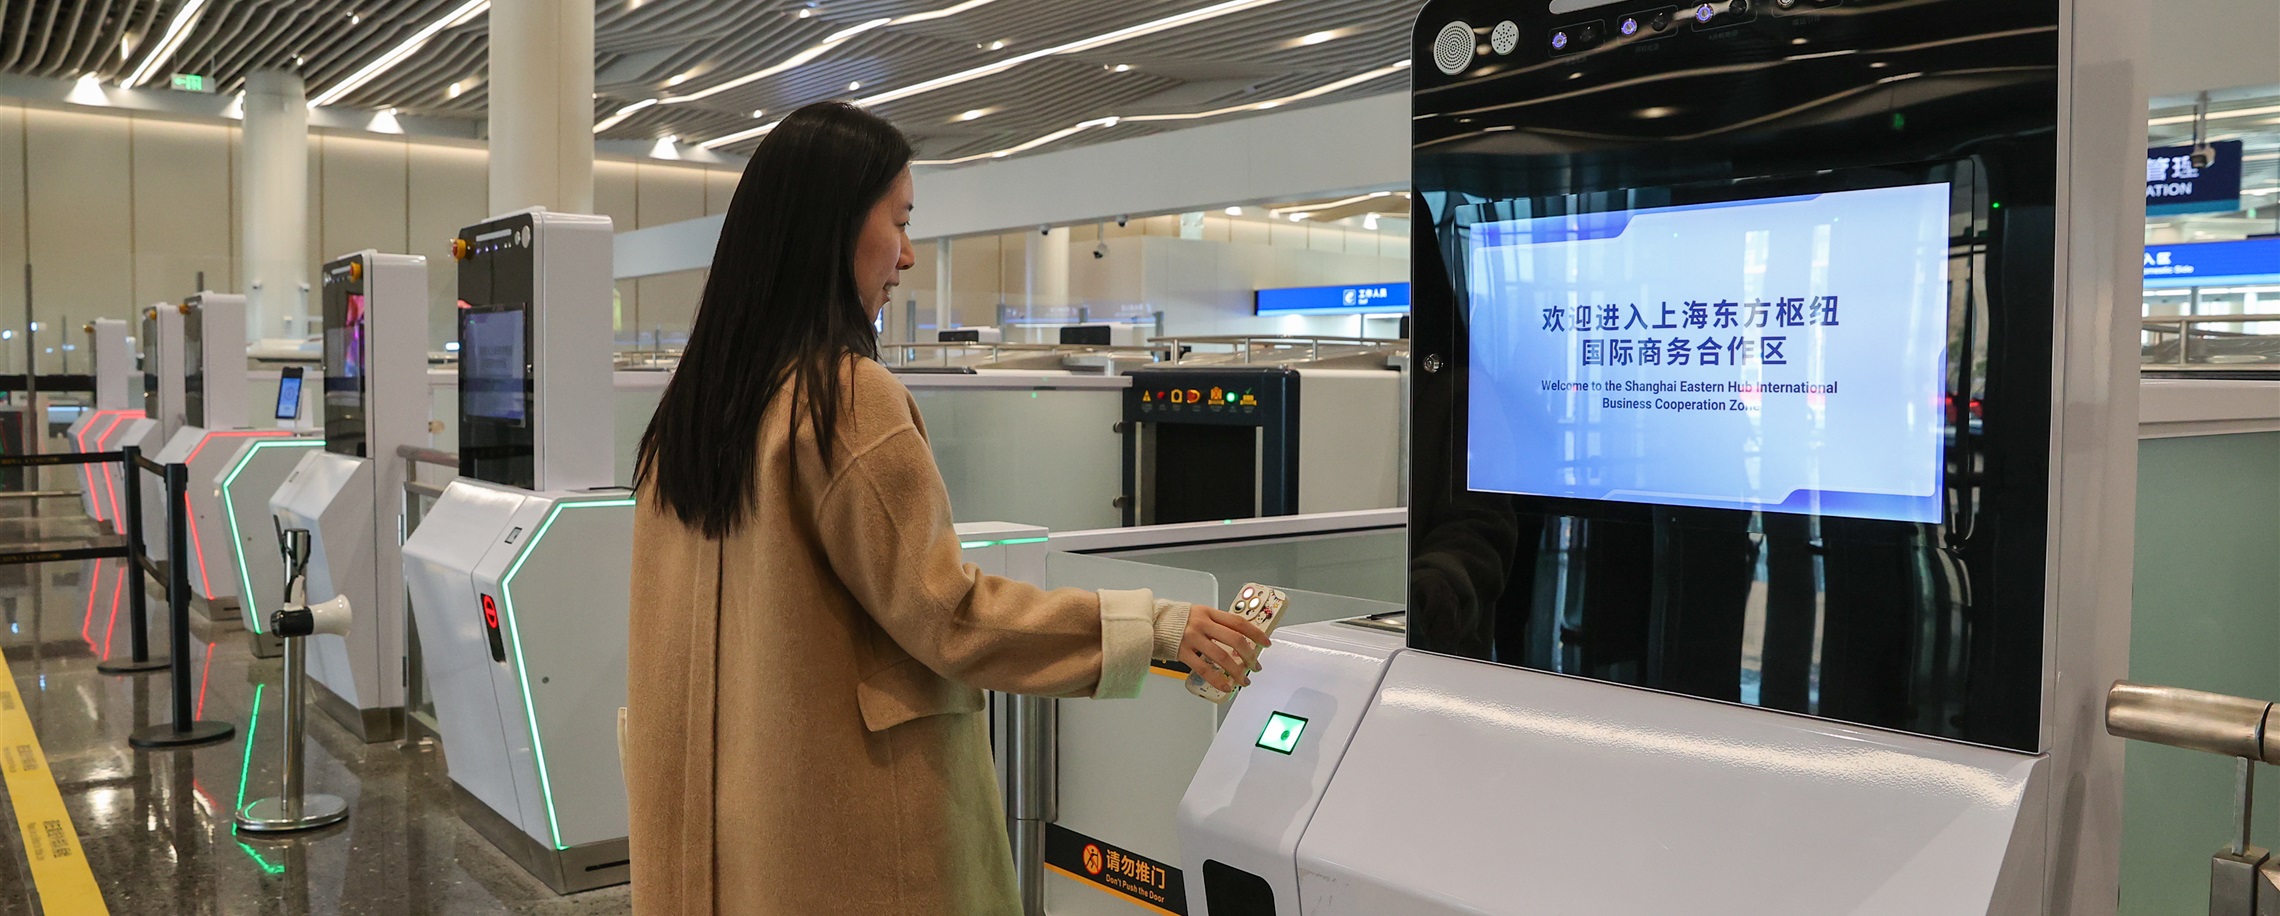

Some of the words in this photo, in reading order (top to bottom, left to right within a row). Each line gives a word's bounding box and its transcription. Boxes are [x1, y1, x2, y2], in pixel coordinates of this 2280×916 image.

[2147, 155, 2199, 182] 管理
[1541, 295, 1840, 333] 欢迎进入上海东方枢纽
[1582, 335, 1788, 367] 国际商务合作区
[1541, 380, 1588, 392] Welcome
[1591, 381, 1602, 392] to
[1605, 380, 1622, 392] the
[1625, 380, 1677, 395] Shanghai
[1680, 381, 1724, 393] Eastern
[1728, 381, 1753, 393] Hub
[1756, 381, 1838, 394] International
[1602, 397, 1652, 409] Business
[1655, 398, 1726, 412] Cooperation
[1106, 849, 1166, 890] 请勿推门
[1106, 873, 1122, 887] Don't
[1122, 880, 1138, 893] Push
[1138, 886, 1148, 898] the
[1149, 890, 1165, 903] Door
